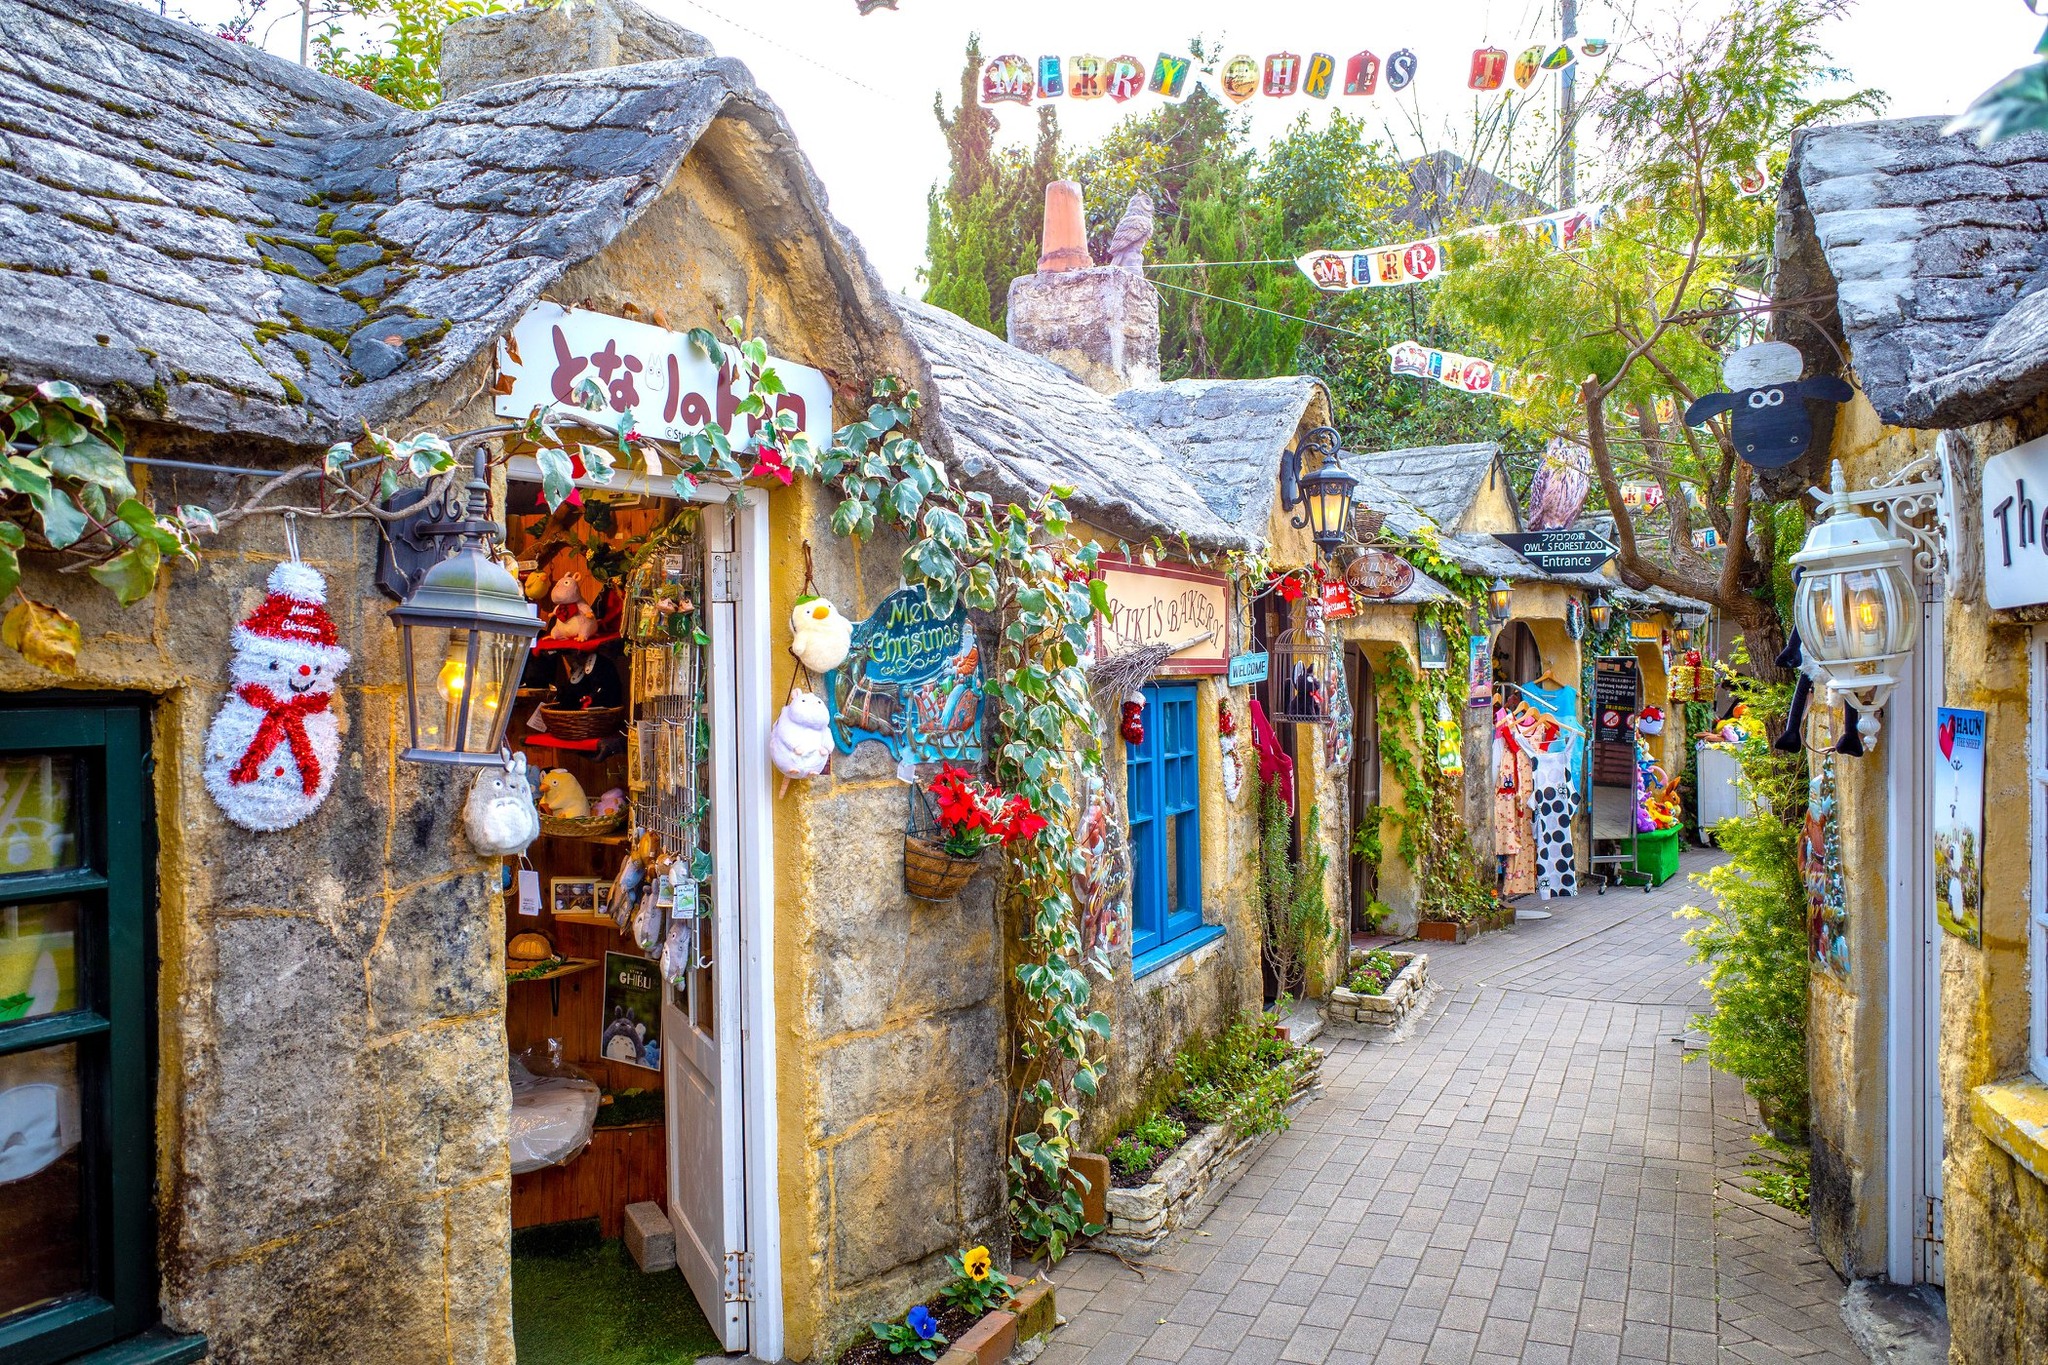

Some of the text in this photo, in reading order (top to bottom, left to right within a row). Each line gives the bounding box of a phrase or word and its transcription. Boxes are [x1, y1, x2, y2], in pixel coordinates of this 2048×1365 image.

[987, 56, 1188, 98] MERRY
[1317, 249, 1434, 283] MERR
[1542, 532, 1586, 542] フクロウの森
[1554, 541, 1584, 551] FOREST
[1585, 541, 1604, 550] ZOO
[1542, 556, 1591, 567] Entrance
[1351, 574, 1408, 588] BAKERY
[288, 606, 315, 616] Merry
[886, 596, 936, 630] Mer
[1109, 589, 1224, 649] KIKI'S BAKERY
[870, 622, 960, 664] Christmas
[1232, 660, 1266, 678] WELCOME
